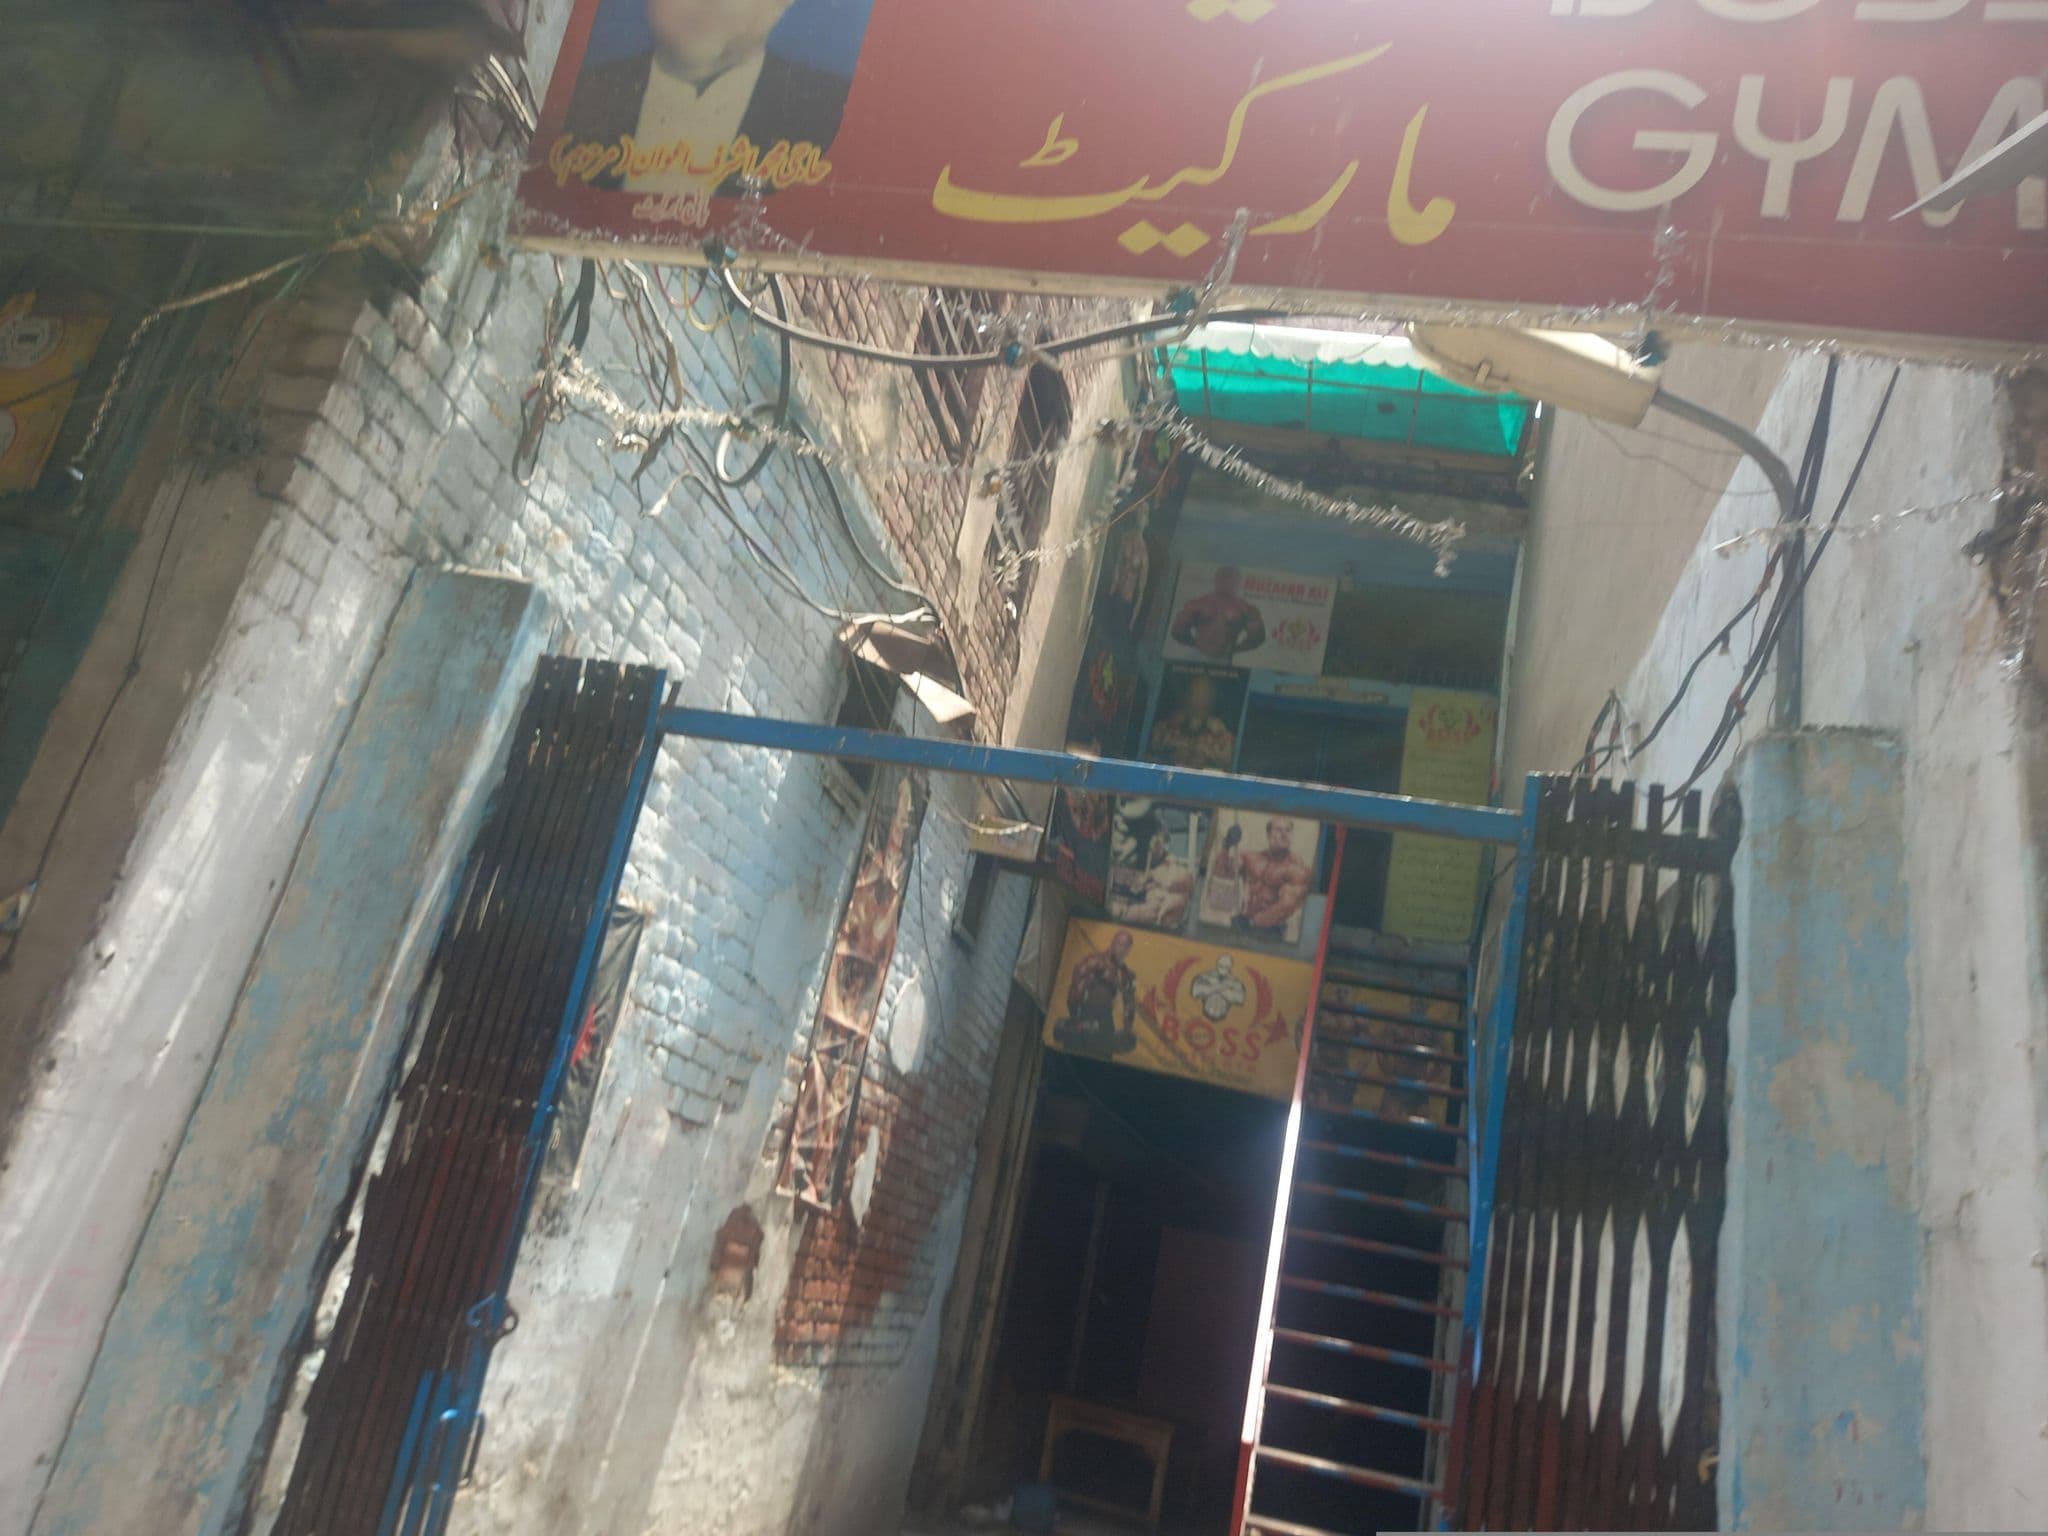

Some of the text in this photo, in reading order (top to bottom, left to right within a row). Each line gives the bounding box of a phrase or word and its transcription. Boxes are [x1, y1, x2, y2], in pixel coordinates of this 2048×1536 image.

[932, 41, 1456, 257] مارکیٹ
[1545, 68, 2048, 230] GYM
[1161, 1013, 1262, 1063] BOSS
